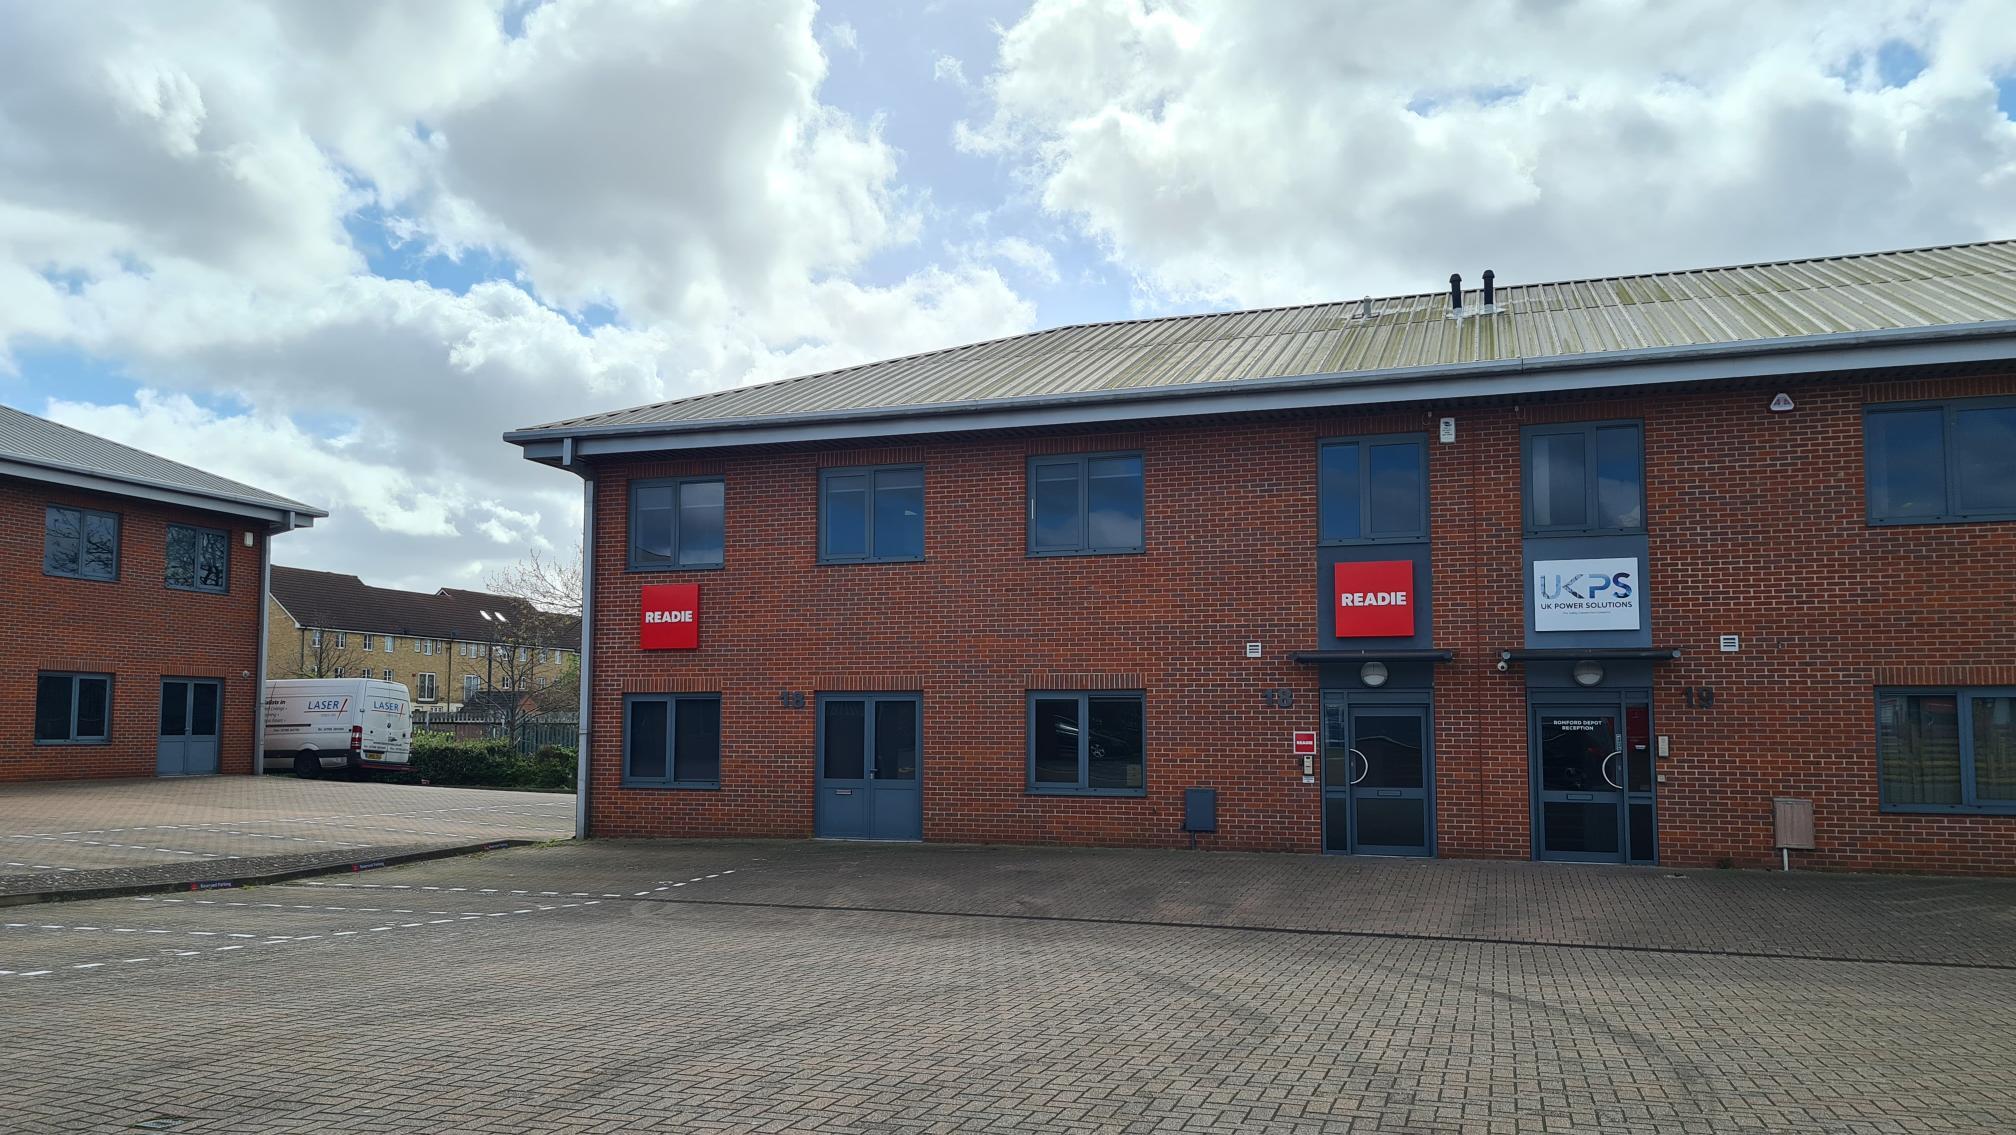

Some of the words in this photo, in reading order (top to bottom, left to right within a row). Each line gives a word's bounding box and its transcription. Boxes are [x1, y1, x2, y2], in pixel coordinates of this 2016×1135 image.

[1540, 572, 1632, 599] UKPS
[1341, 592, 1407, 607] READIE
[645, 610, 693, 623] READIE
[1263, 688, 1293, 707] 18
[1684, 686, 1714, 708] 19
[307, 700, 339, 710] LASER
[373, 700, 399, 712] LASER
